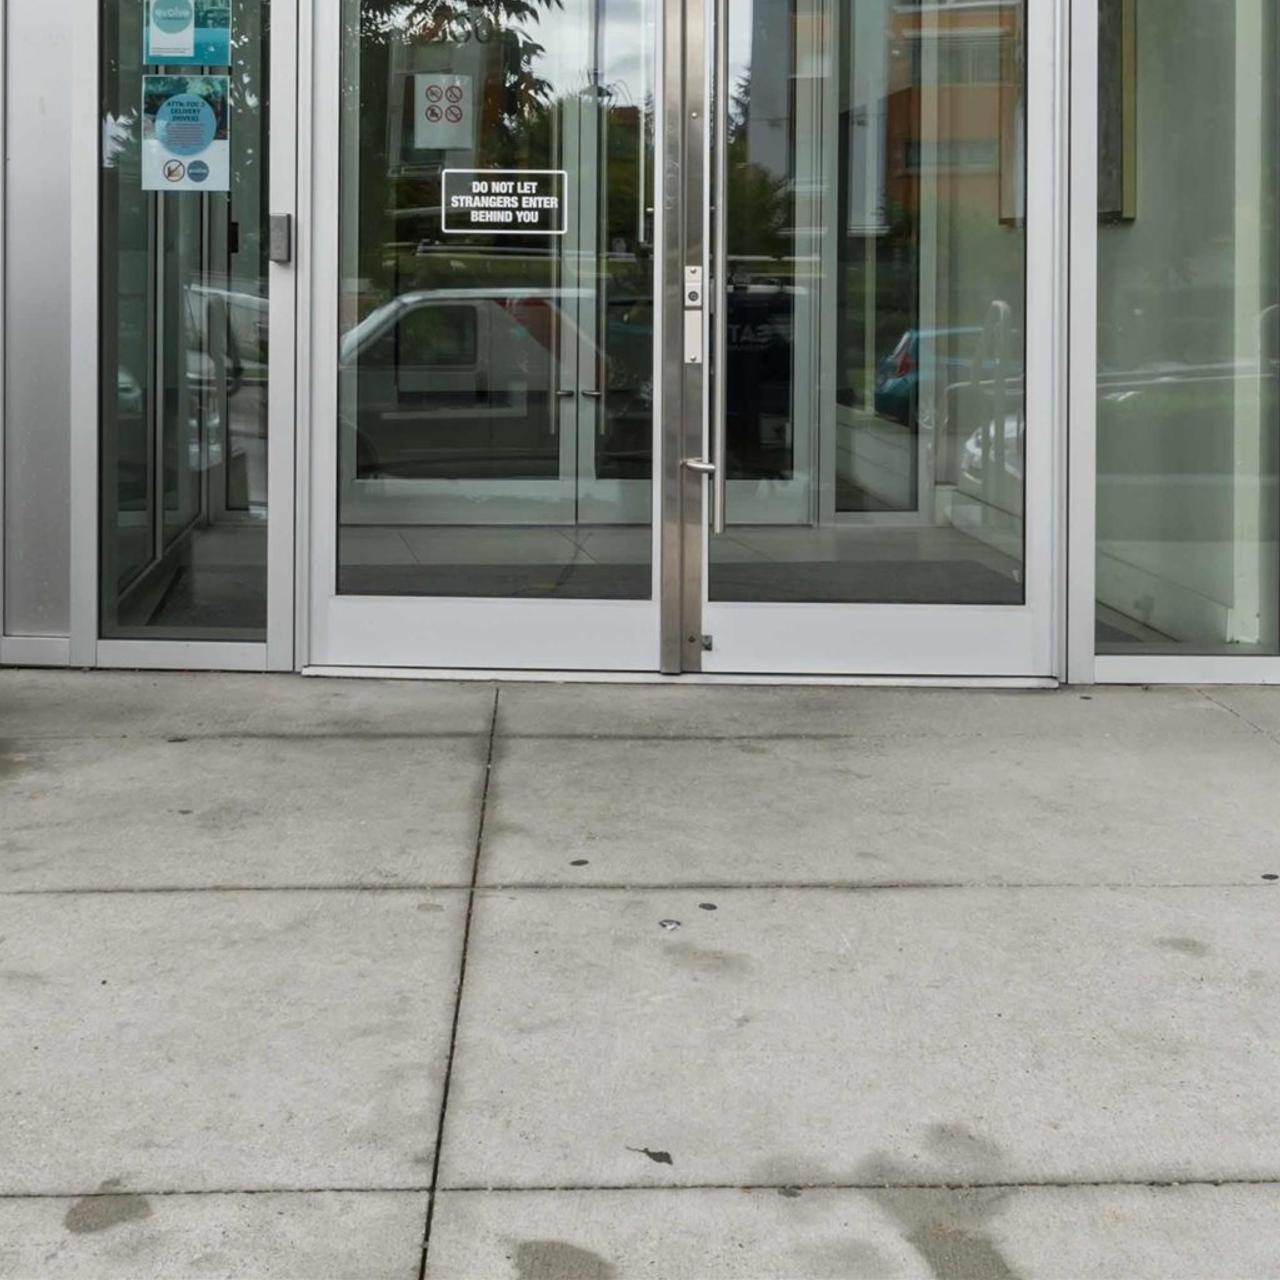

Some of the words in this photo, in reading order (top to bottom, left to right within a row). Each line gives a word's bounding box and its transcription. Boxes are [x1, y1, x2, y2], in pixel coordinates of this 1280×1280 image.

[471, 181, 488, 194] DO
[491, 181, 515, 194] NOT
[517, 181, 538, 194] LET
[451, 196, 519, 209] STRANGERS
[521, 196, 558, 209] ENTER
[470, 210, 512, 223] BEHIND
[515, 210, 539, 224] YOU
